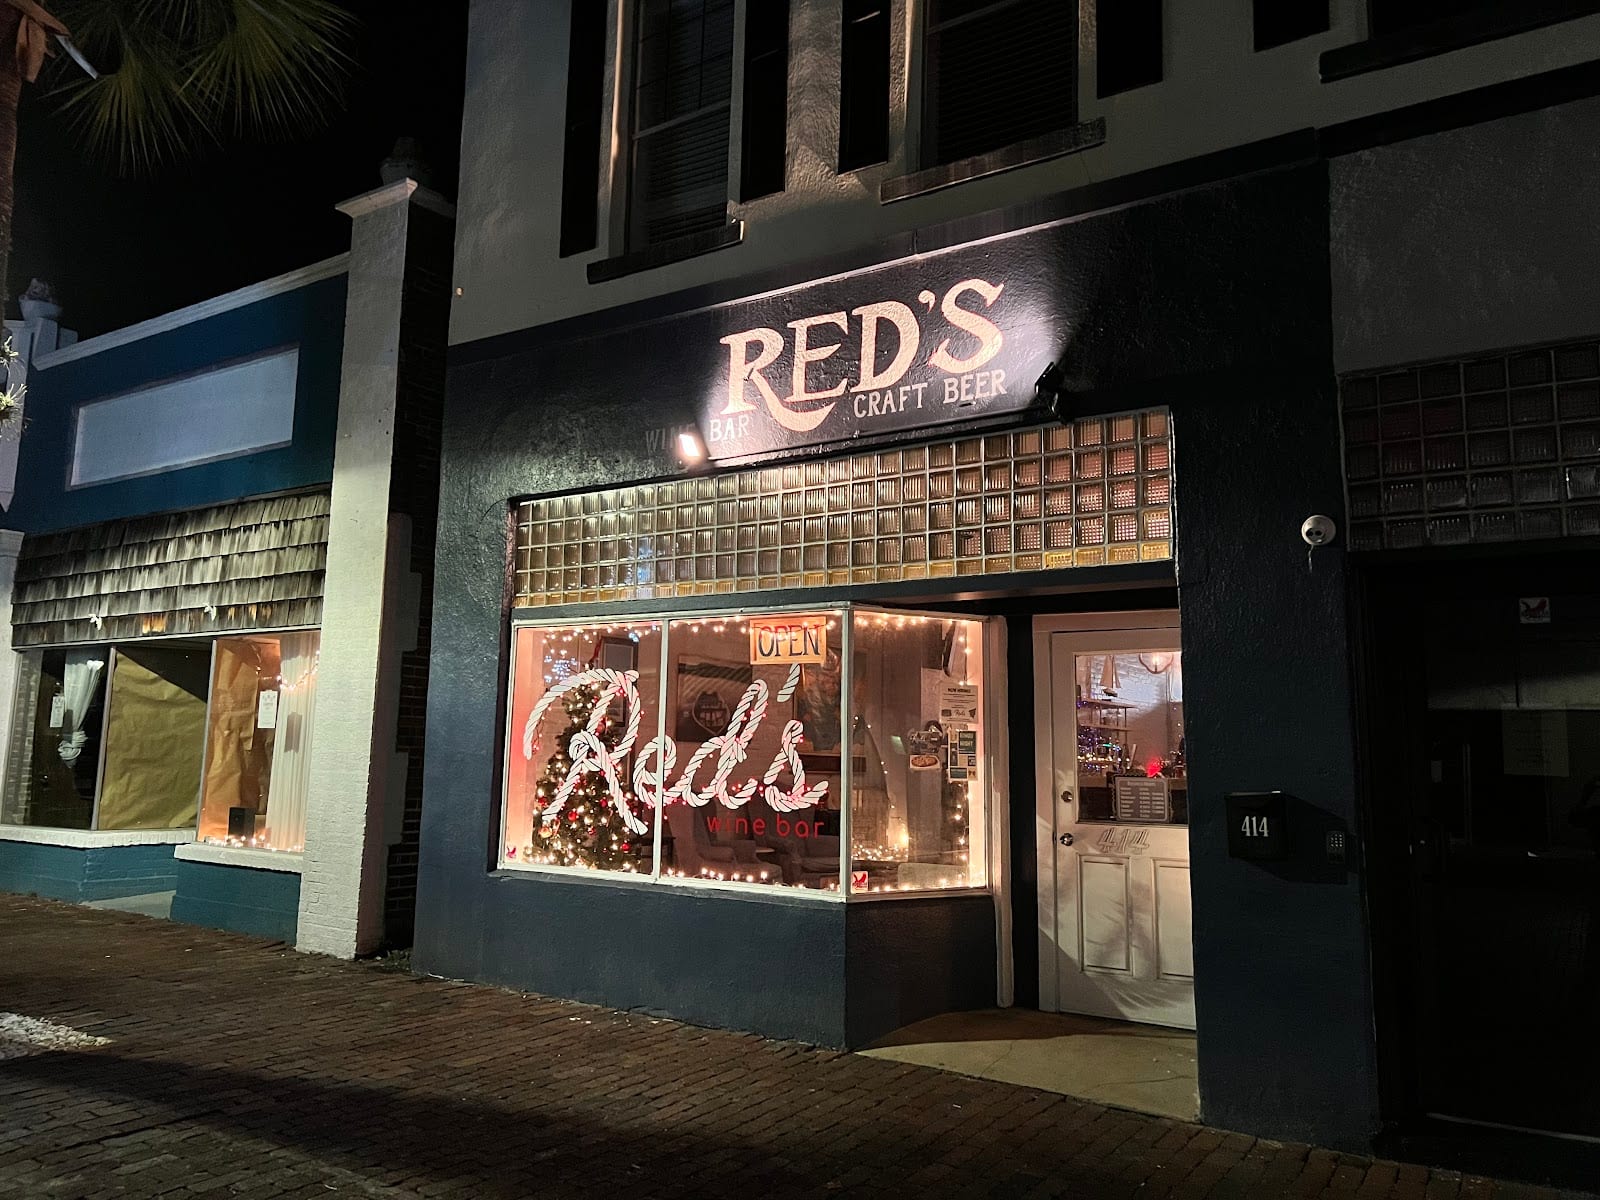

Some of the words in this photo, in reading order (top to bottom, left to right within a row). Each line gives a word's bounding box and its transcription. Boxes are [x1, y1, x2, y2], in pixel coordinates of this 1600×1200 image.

[720, 278, 1004, 432] RED'S
[709, 415, 750, 441] BAR
[854, 383, 927, 419] CRAFT
[943, 369, 1007, 404] BEER
[759, 623, 821, 657] OPEN
[523, 664, 829, 836] Red's
[707, 813, 766, 836] wine
[776, 814, 825, 838] bar
[1097, 827, 1150, 855] 414
[1241, 815, 1269, 837] 414
